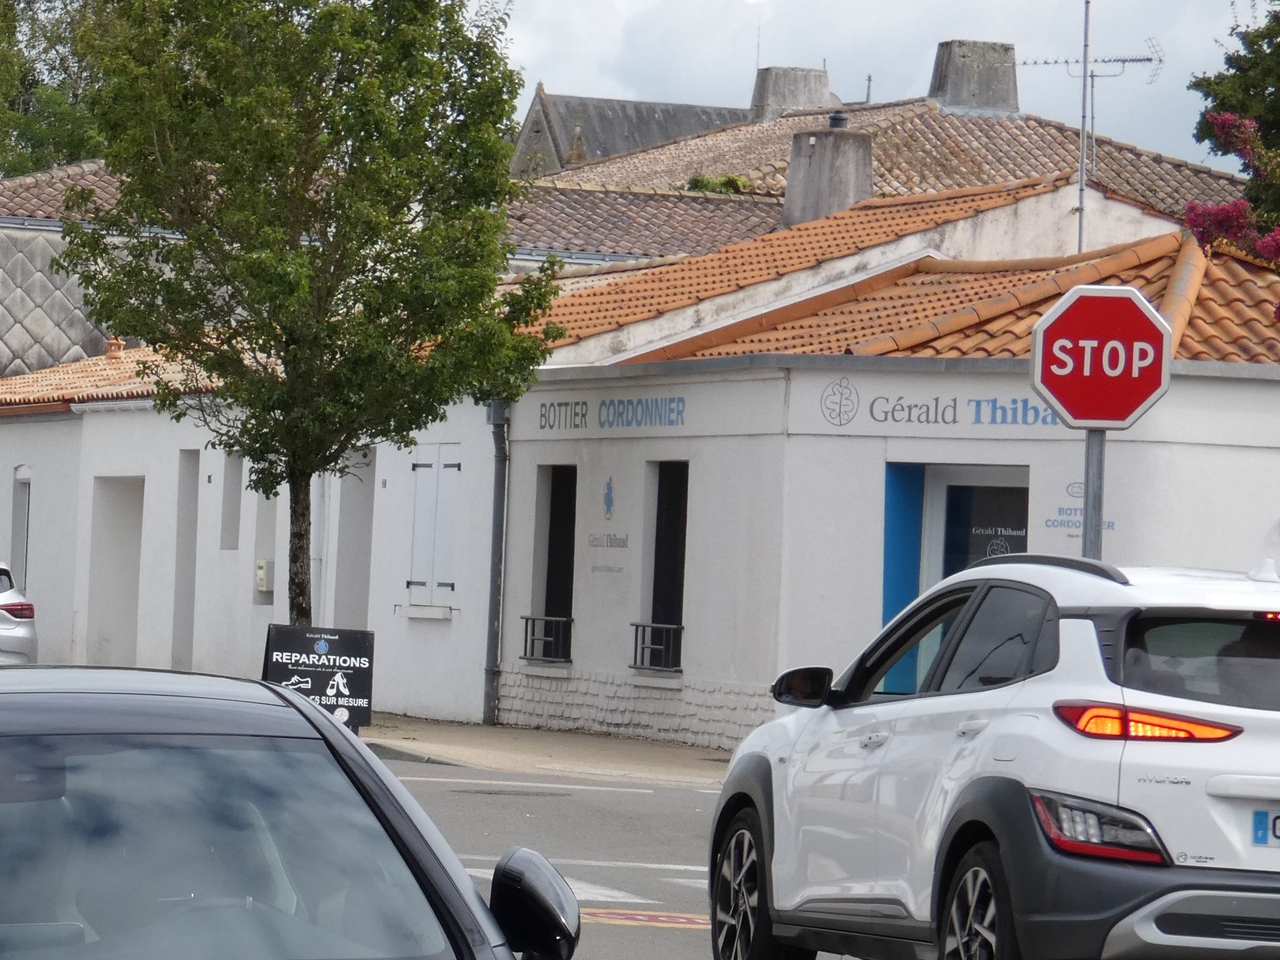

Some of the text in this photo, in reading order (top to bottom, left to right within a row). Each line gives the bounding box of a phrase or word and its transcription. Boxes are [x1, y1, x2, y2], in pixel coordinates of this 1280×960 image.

[1050, 339, 1155, 377] STOP
[539, 397, 686, 430] BOTTIER CORDONNIER
[869, 396, 1060, 425] Gérald Thiba
[1058, 507, 1084, 516] BOTT
[972, 527, 1026, 536] Gérald Thibaud
[272, 652, 369, 668] REPARATIONS
[321, 696, 337, 705] SUR
[338, 697, 368, 707] MESURE
